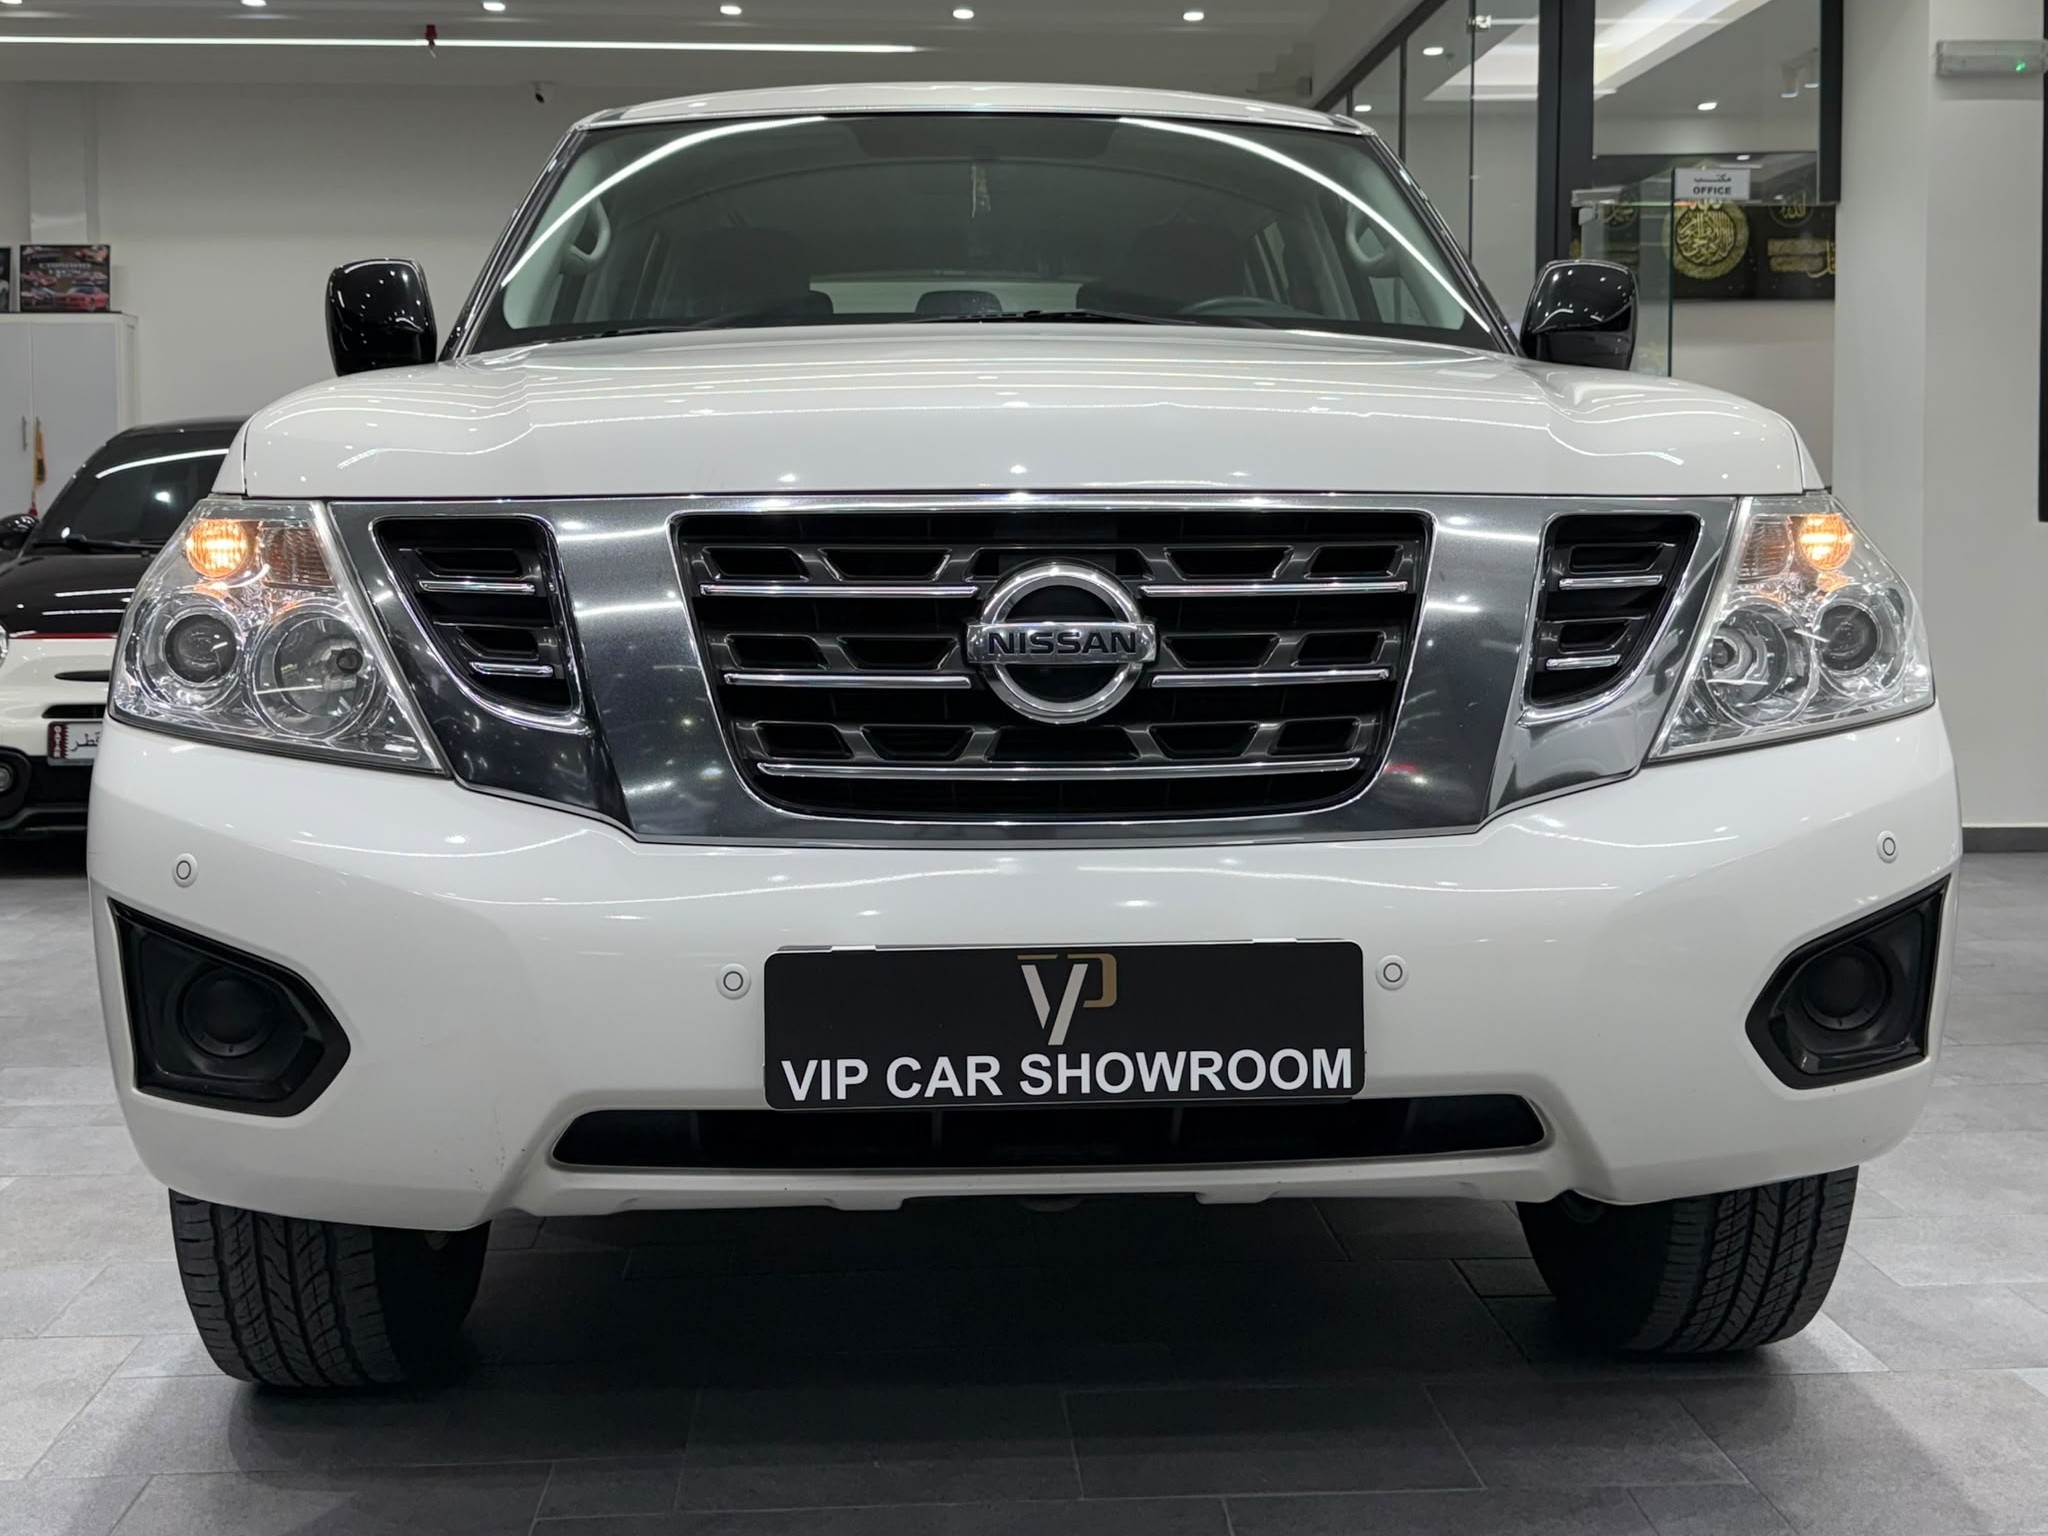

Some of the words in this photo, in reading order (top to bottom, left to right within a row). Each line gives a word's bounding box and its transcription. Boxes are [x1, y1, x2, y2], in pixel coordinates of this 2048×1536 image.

[1693, 186, 1731, 195] OFFICE
[988, 632, 1137, 654] NISSAN
[781, 1058, 869, 1101] VIP
[886, 1055, 1003, 1099] CAR
[1019, 1048, 1353, 1097] SHOWROOM
